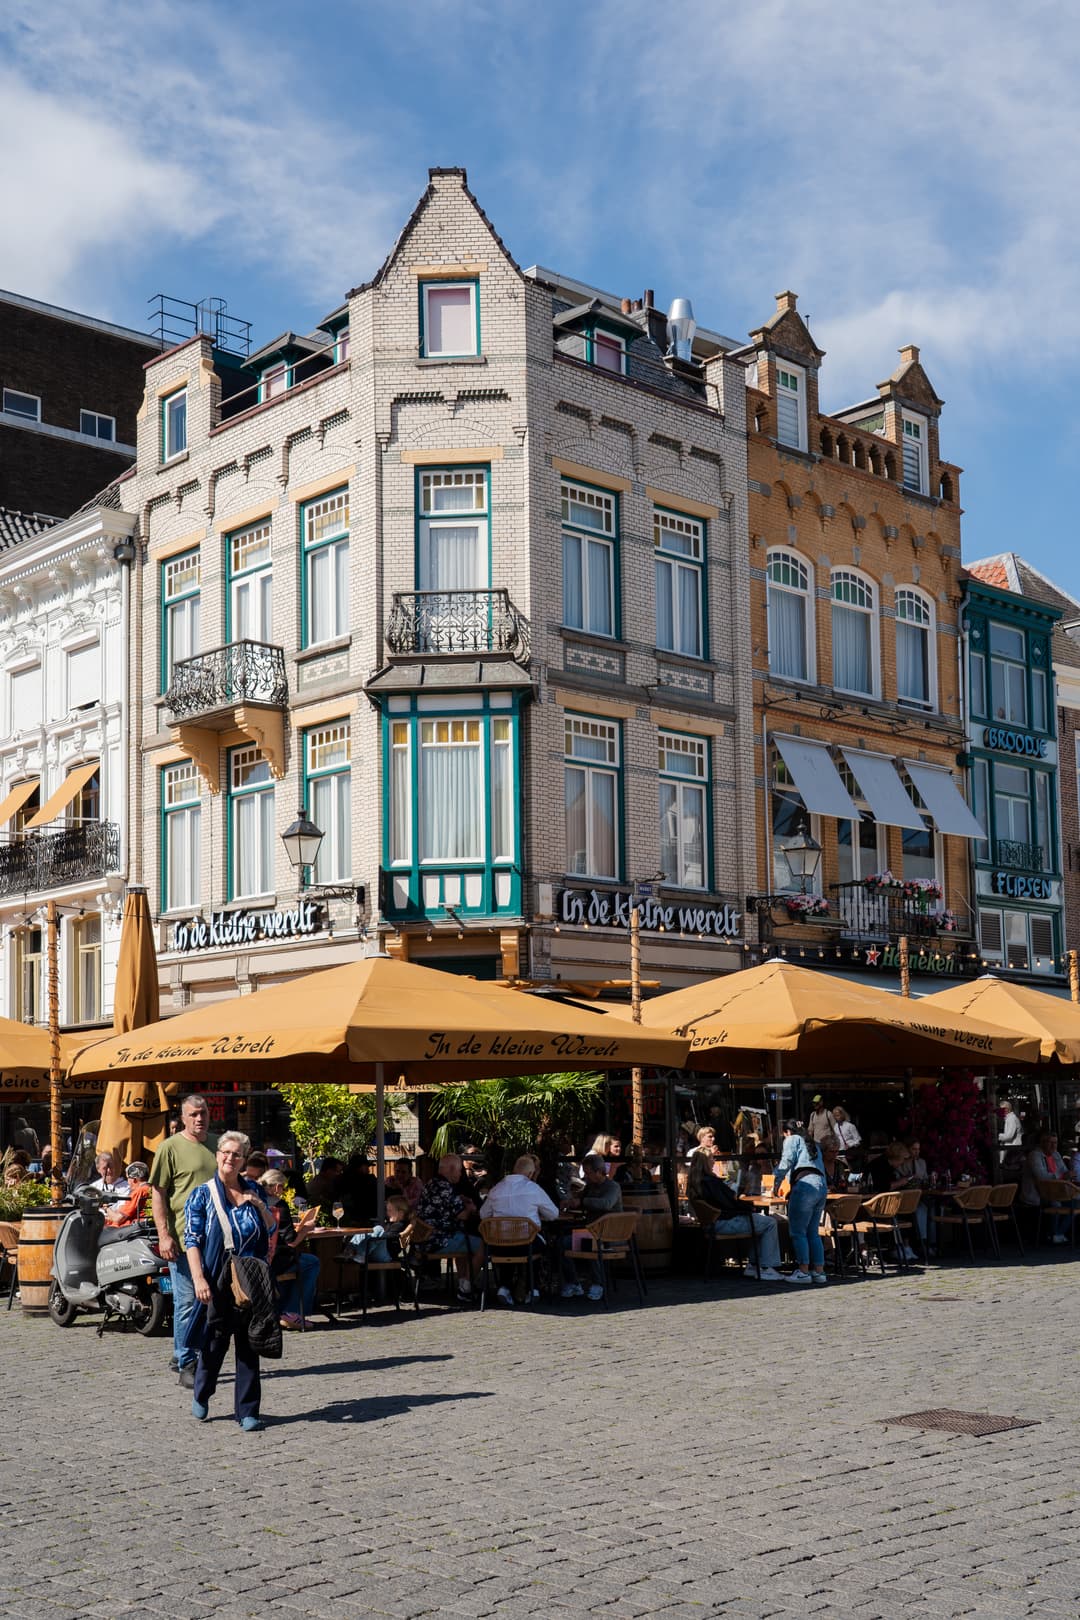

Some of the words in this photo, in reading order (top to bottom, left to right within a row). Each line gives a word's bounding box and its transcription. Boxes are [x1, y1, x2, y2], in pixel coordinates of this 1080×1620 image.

[989, 728, 1048, 757] BROODJE
[997, 872, 1052, 898] FLIPSEN
[174, 920, 188, 950] In
[191, 915, 206, 948] de
[209, 909, 257, 944] kleine
[259, 901, 316, 938] werelt
[563, 890, 584, 921] In
[588, 890, 610, 924] de
[614, 892, 675, 929] kleine
[679, 903, 741, 936] werelt
[882, 947, 955, 973] Heneken
[109, 1048, 131, 1067] In
[133, 1048, 153, 1061] de
[155, 1046, 203, 1059] kleine
[211, 1035, 274, 1054] Werelt
[424, 1032, 451, 1059] In
[457, 1034, 482, 1055] de
[488, 1035, 544, 1056] kleine
[551, 1034, 620, 1057] Werelt
